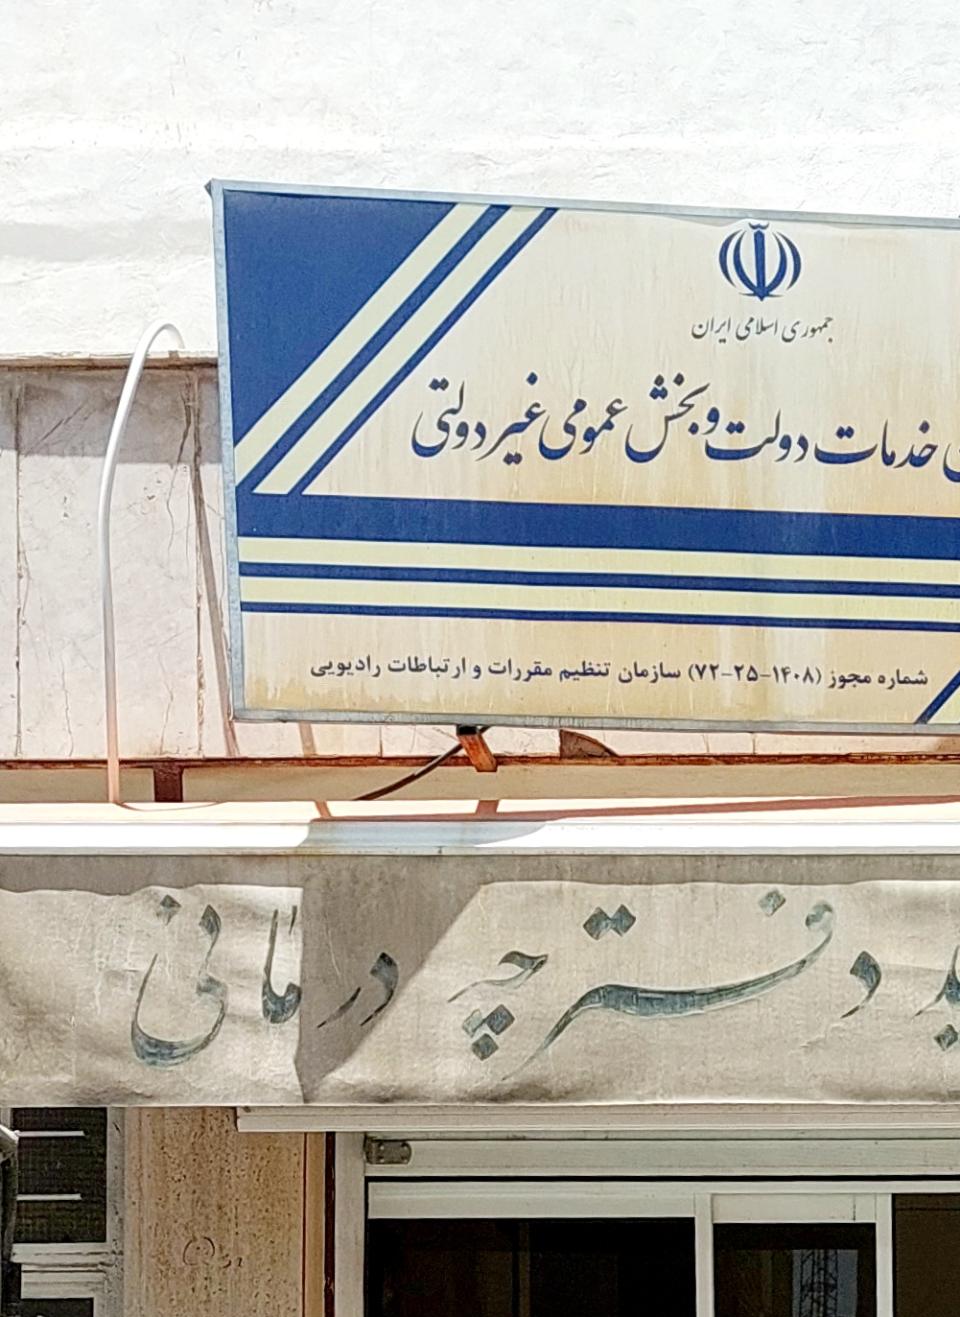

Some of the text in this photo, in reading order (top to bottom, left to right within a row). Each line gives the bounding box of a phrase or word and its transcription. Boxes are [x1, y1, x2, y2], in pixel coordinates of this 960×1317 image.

[691, 316, 834, 344] جمهوری اسلامی ایران
[538, 398, 628, 461] عمومی
[624, 372, 711, 464] بخش
[701, 406, 721, 436] و
[704, 408, 808, 462] دولت
[813, 418, 938, 468] خدمات
[310, 654, 381, 677] رادیویی
[387, 656, 467, 679] ارتباطات
[472, 662, 482, 679] و
[487, 659, 553, 682] مقررات
[558, 659, 611, 682] تنظیم
[617, 661, 681, 683] سازمان
[827, 671, 872, 689] مجوز
[877, 668, 929, 690] شماره
